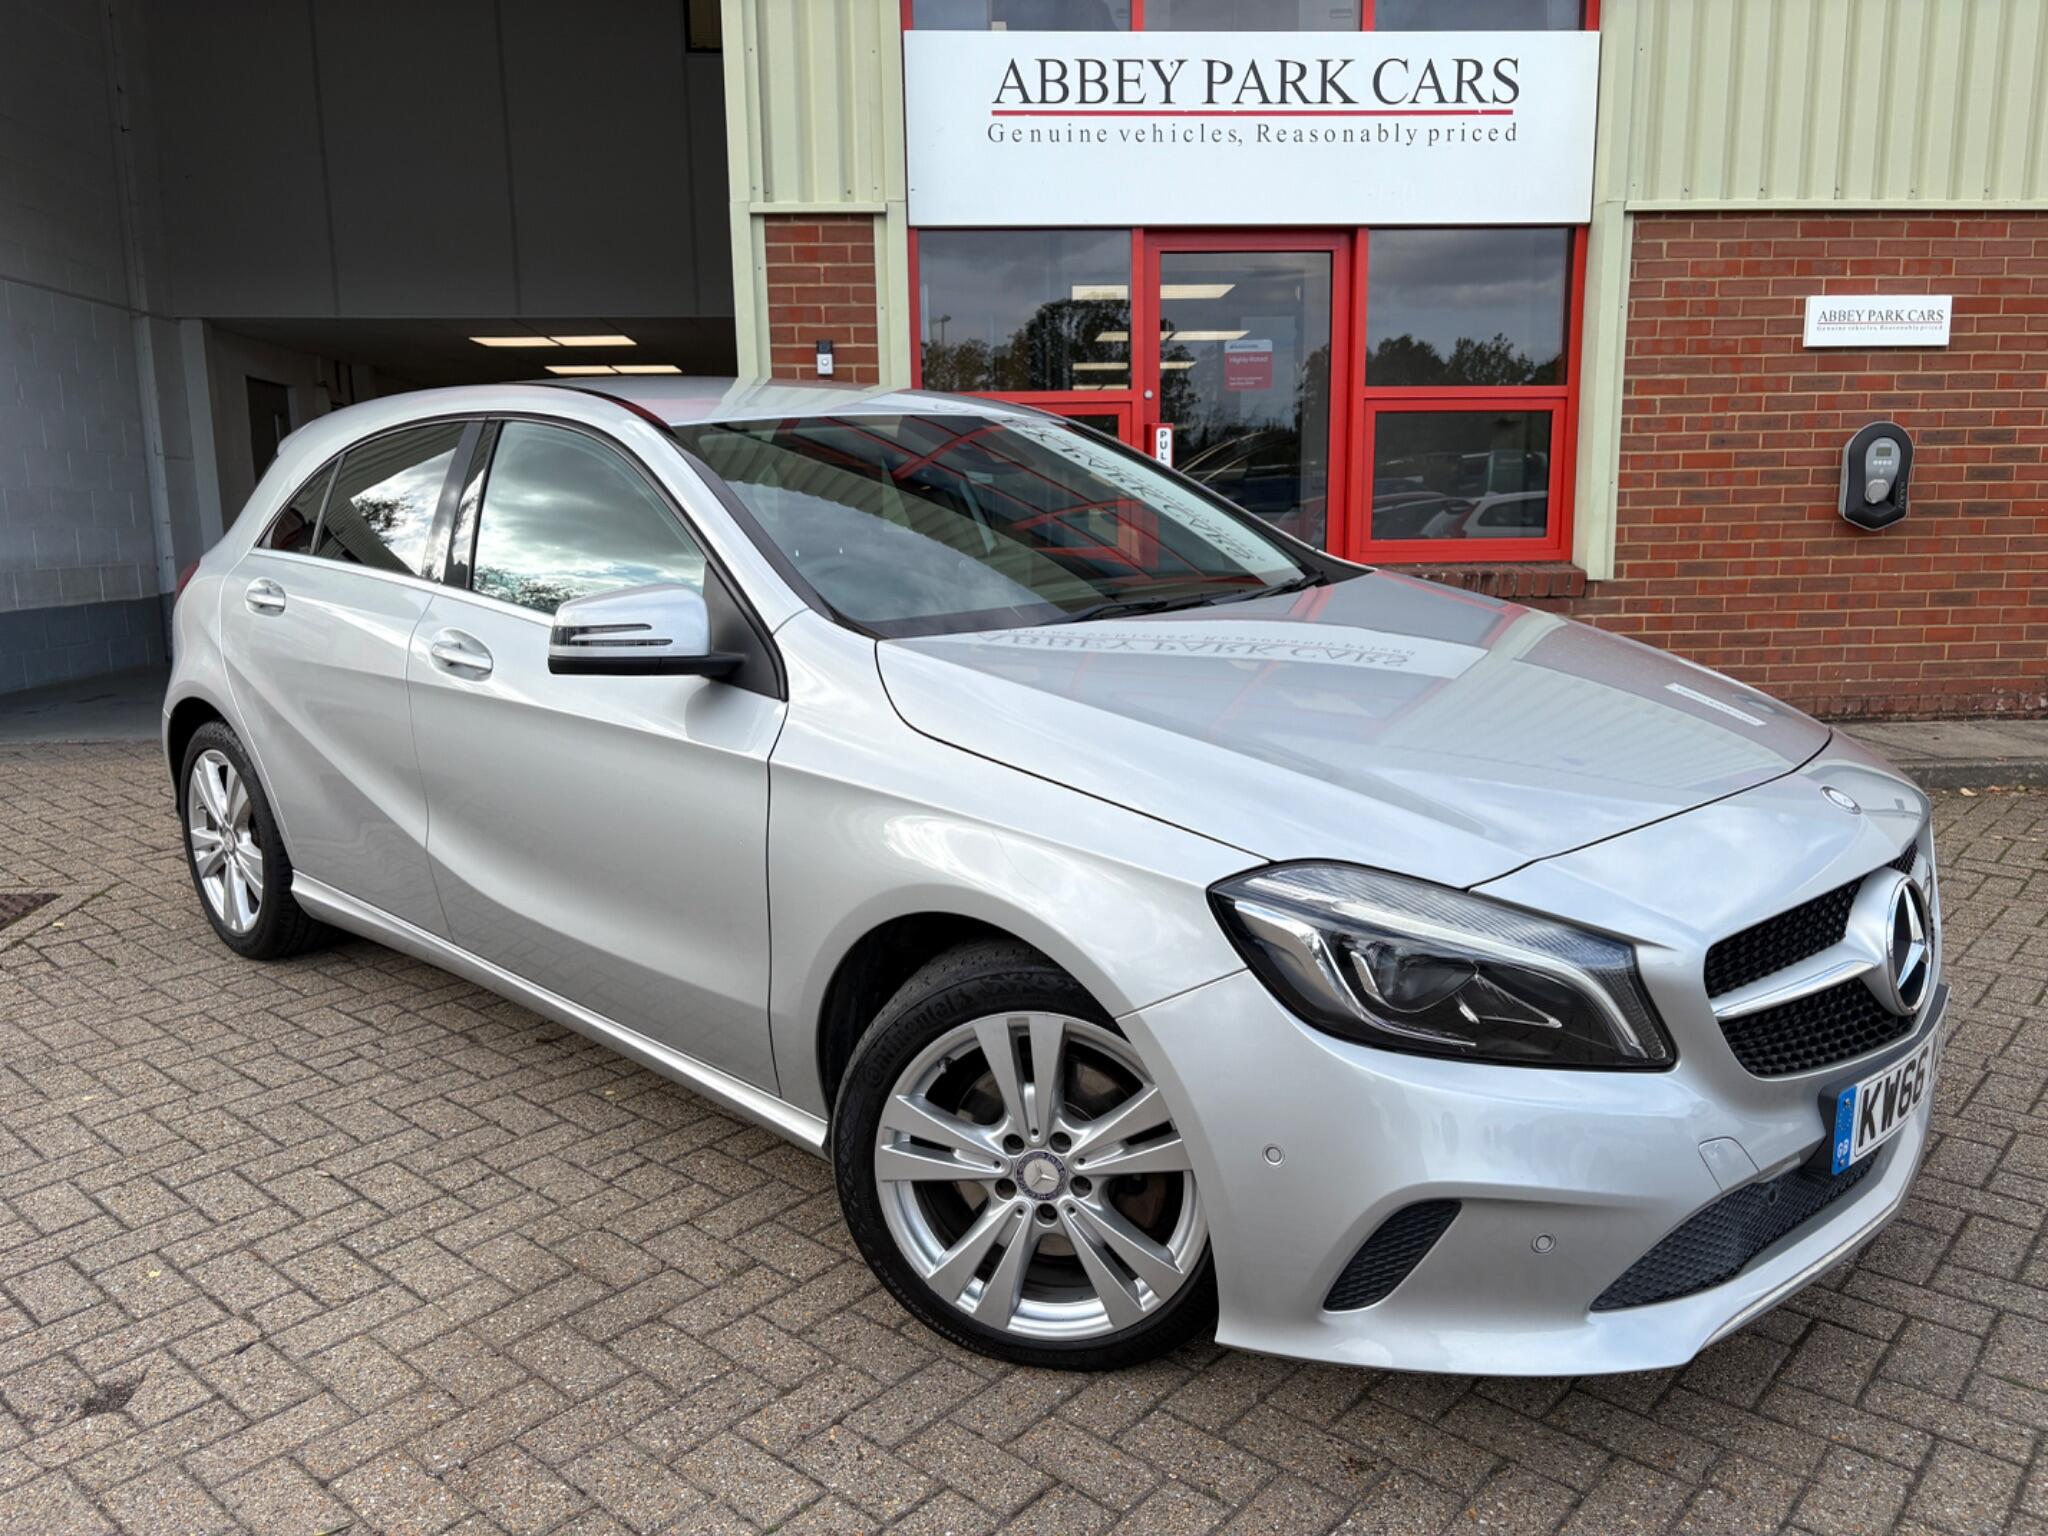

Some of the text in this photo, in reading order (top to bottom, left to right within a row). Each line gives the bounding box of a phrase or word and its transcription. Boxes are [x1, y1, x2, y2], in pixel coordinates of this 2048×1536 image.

[992, 57, 1520, 105] ABBEY PARK CARS
[987, 122, 1518, 146] Genuine vehicles, Reasonably priced
[1818, 309, 1945, 322] ABBEY PARK CARS
[1160, 430, 1168, 460] PUL
[1858, 1046, 1929, 1148] KW66
